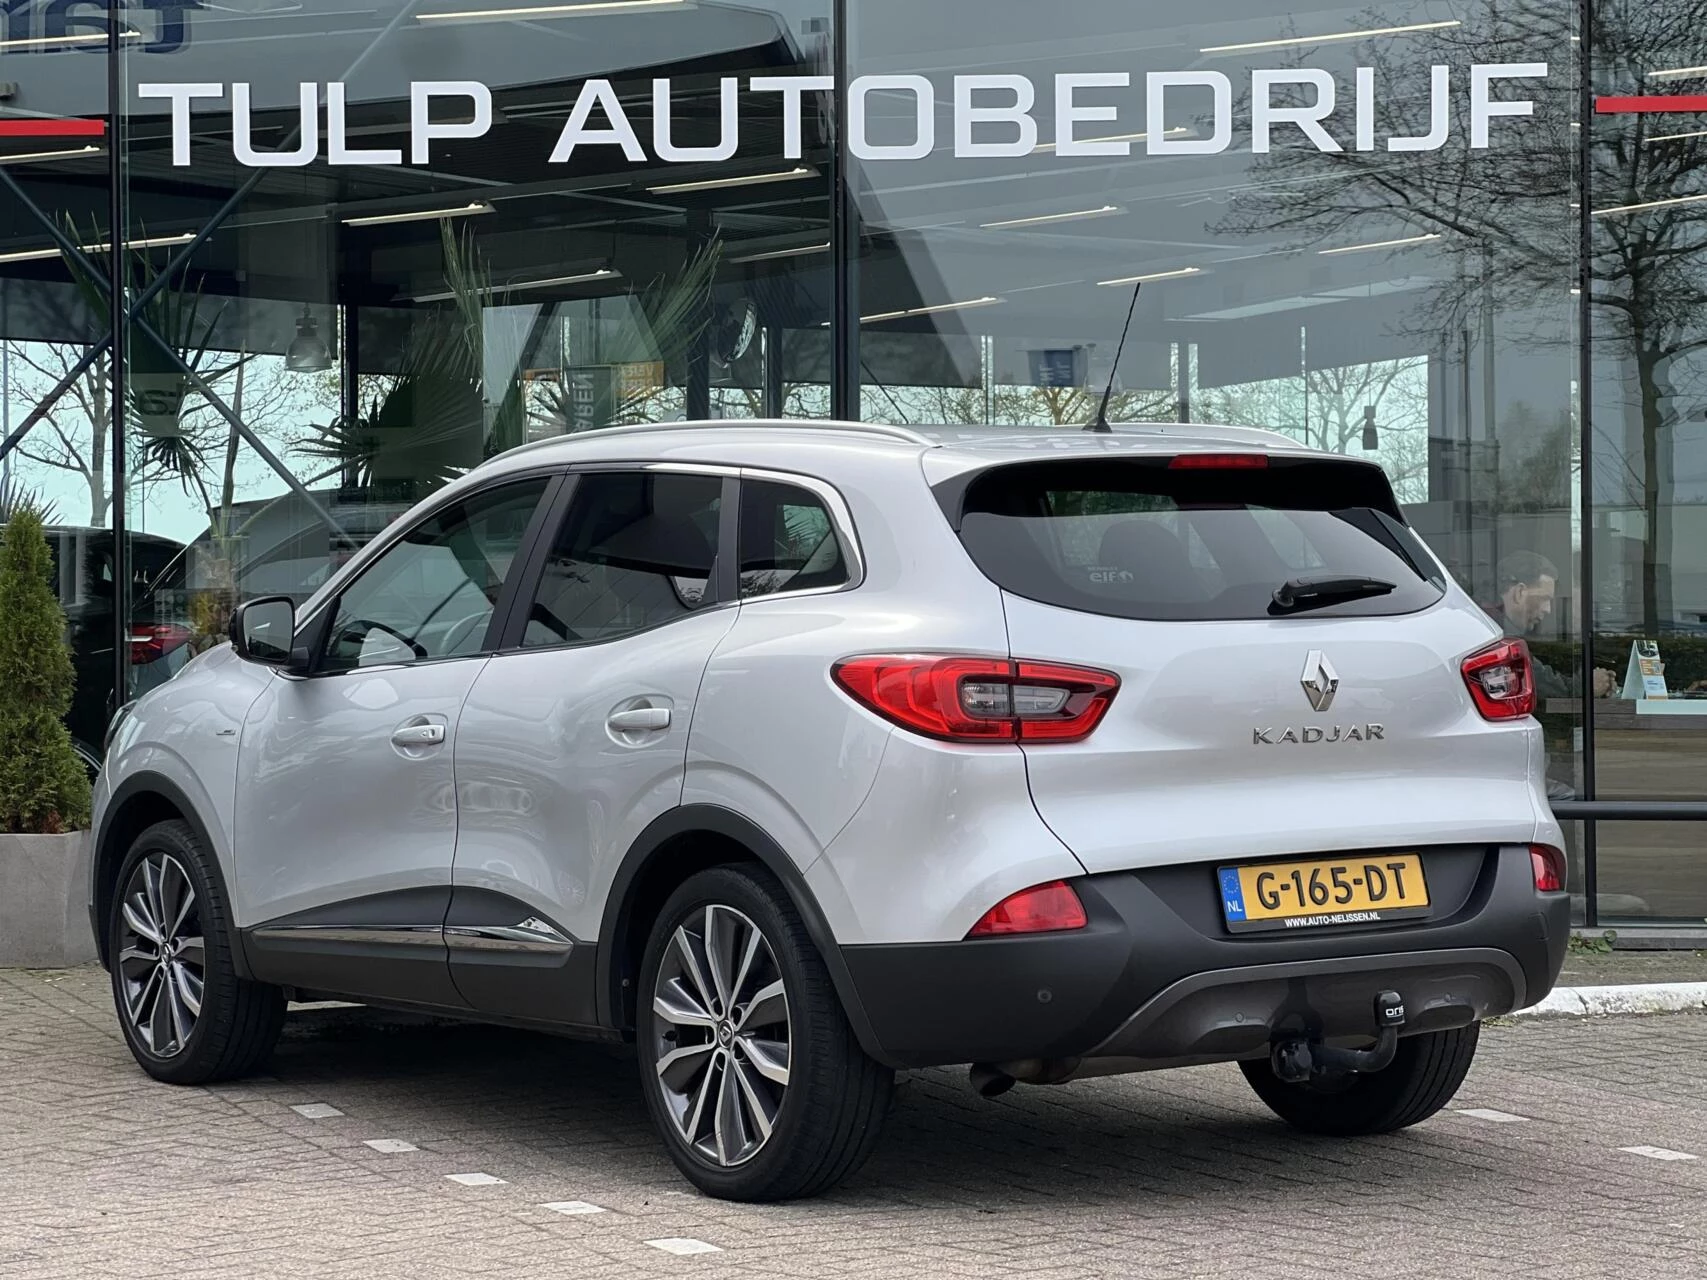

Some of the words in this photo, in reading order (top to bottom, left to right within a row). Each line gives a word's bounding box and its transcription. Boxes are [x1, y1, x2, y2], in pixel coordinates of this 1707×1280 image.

[138, 81, 492, 167] TULP
[548, 62, 1548, 164] AUTOBEDRIJF
[1253, 723, 1385, 745] KADJAR
[1256, 862, 1406, 910] G-165-DT
[1226, 900, 1243, 913] NL
[1284, 911, 1381, 928] WWW.AUTO-NELISSEN.NL
